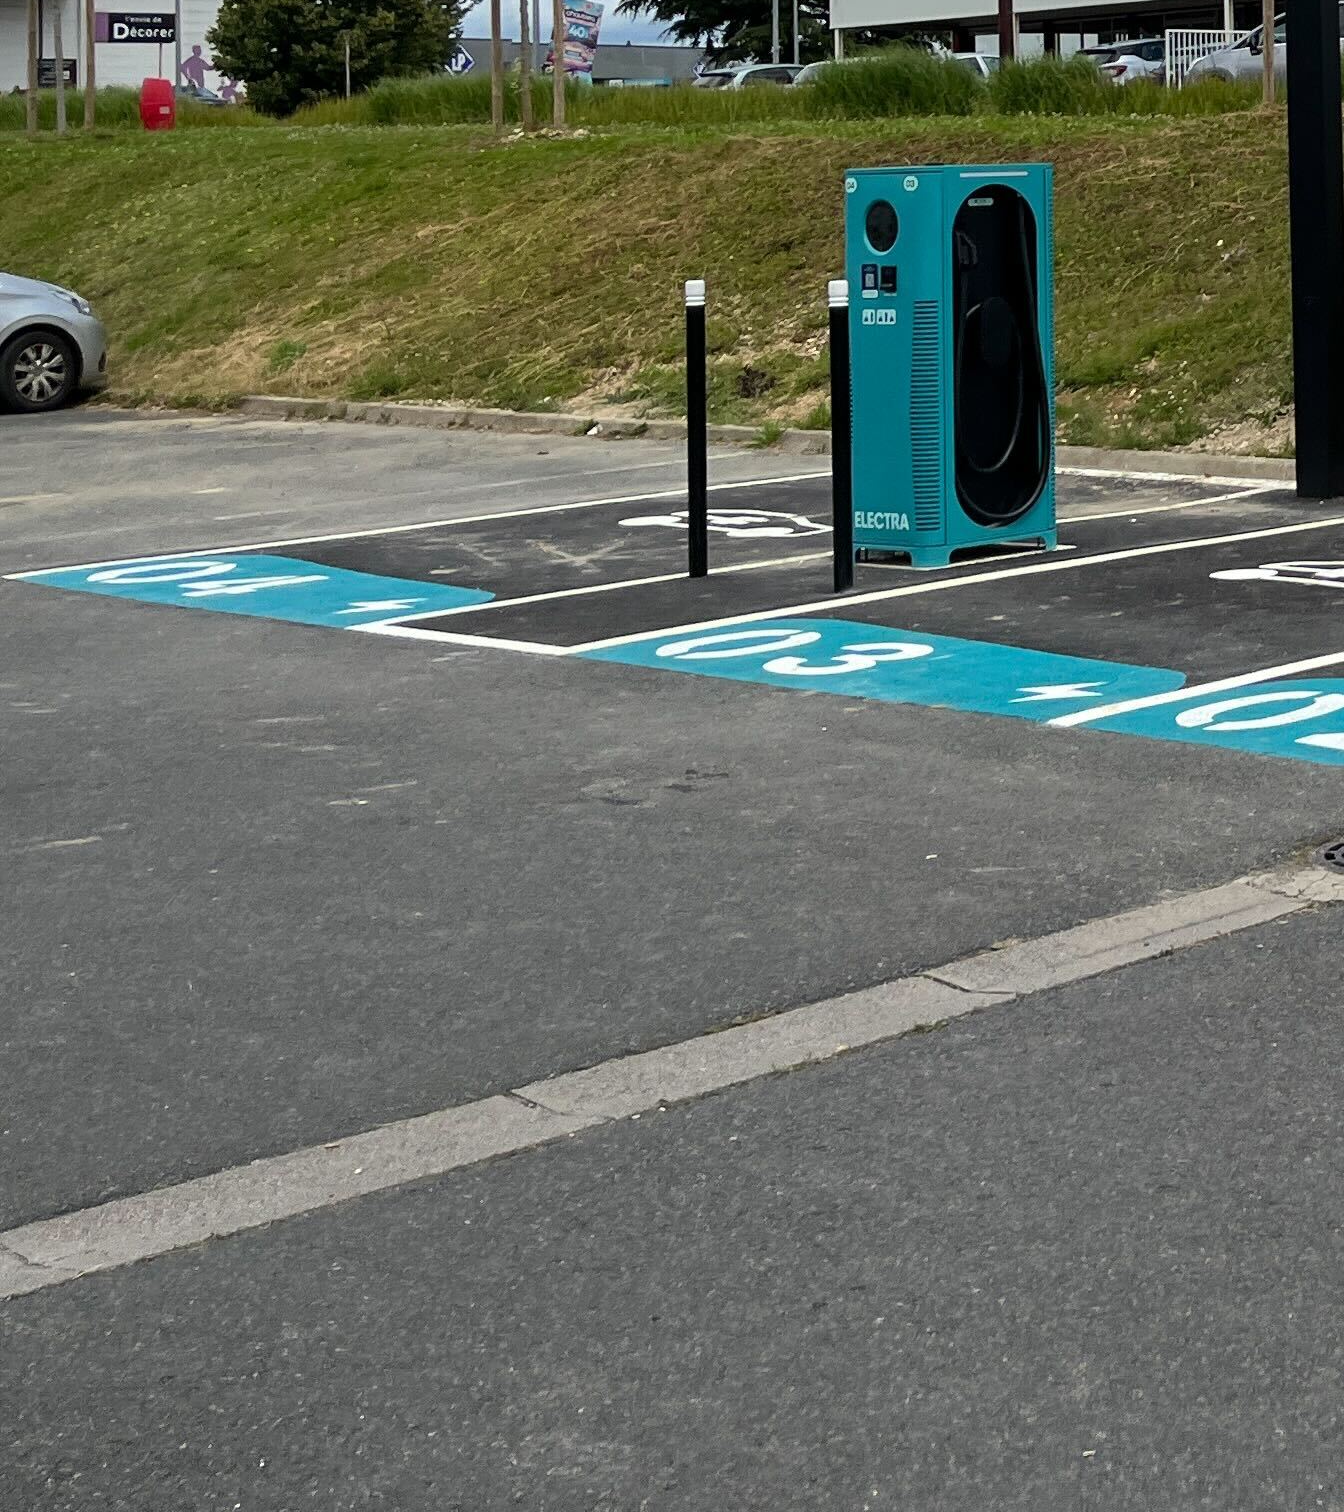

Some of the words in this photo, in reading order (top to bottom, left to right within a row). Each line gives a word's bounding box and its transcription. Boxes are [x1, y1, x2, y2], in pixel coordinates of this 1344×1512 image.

[113, 22, 174, 39] Décorer
[855, 511, 910, 531] ELECTRA
[87, 561, 329, 597] 04
[655, 628, 935, 676] 03
